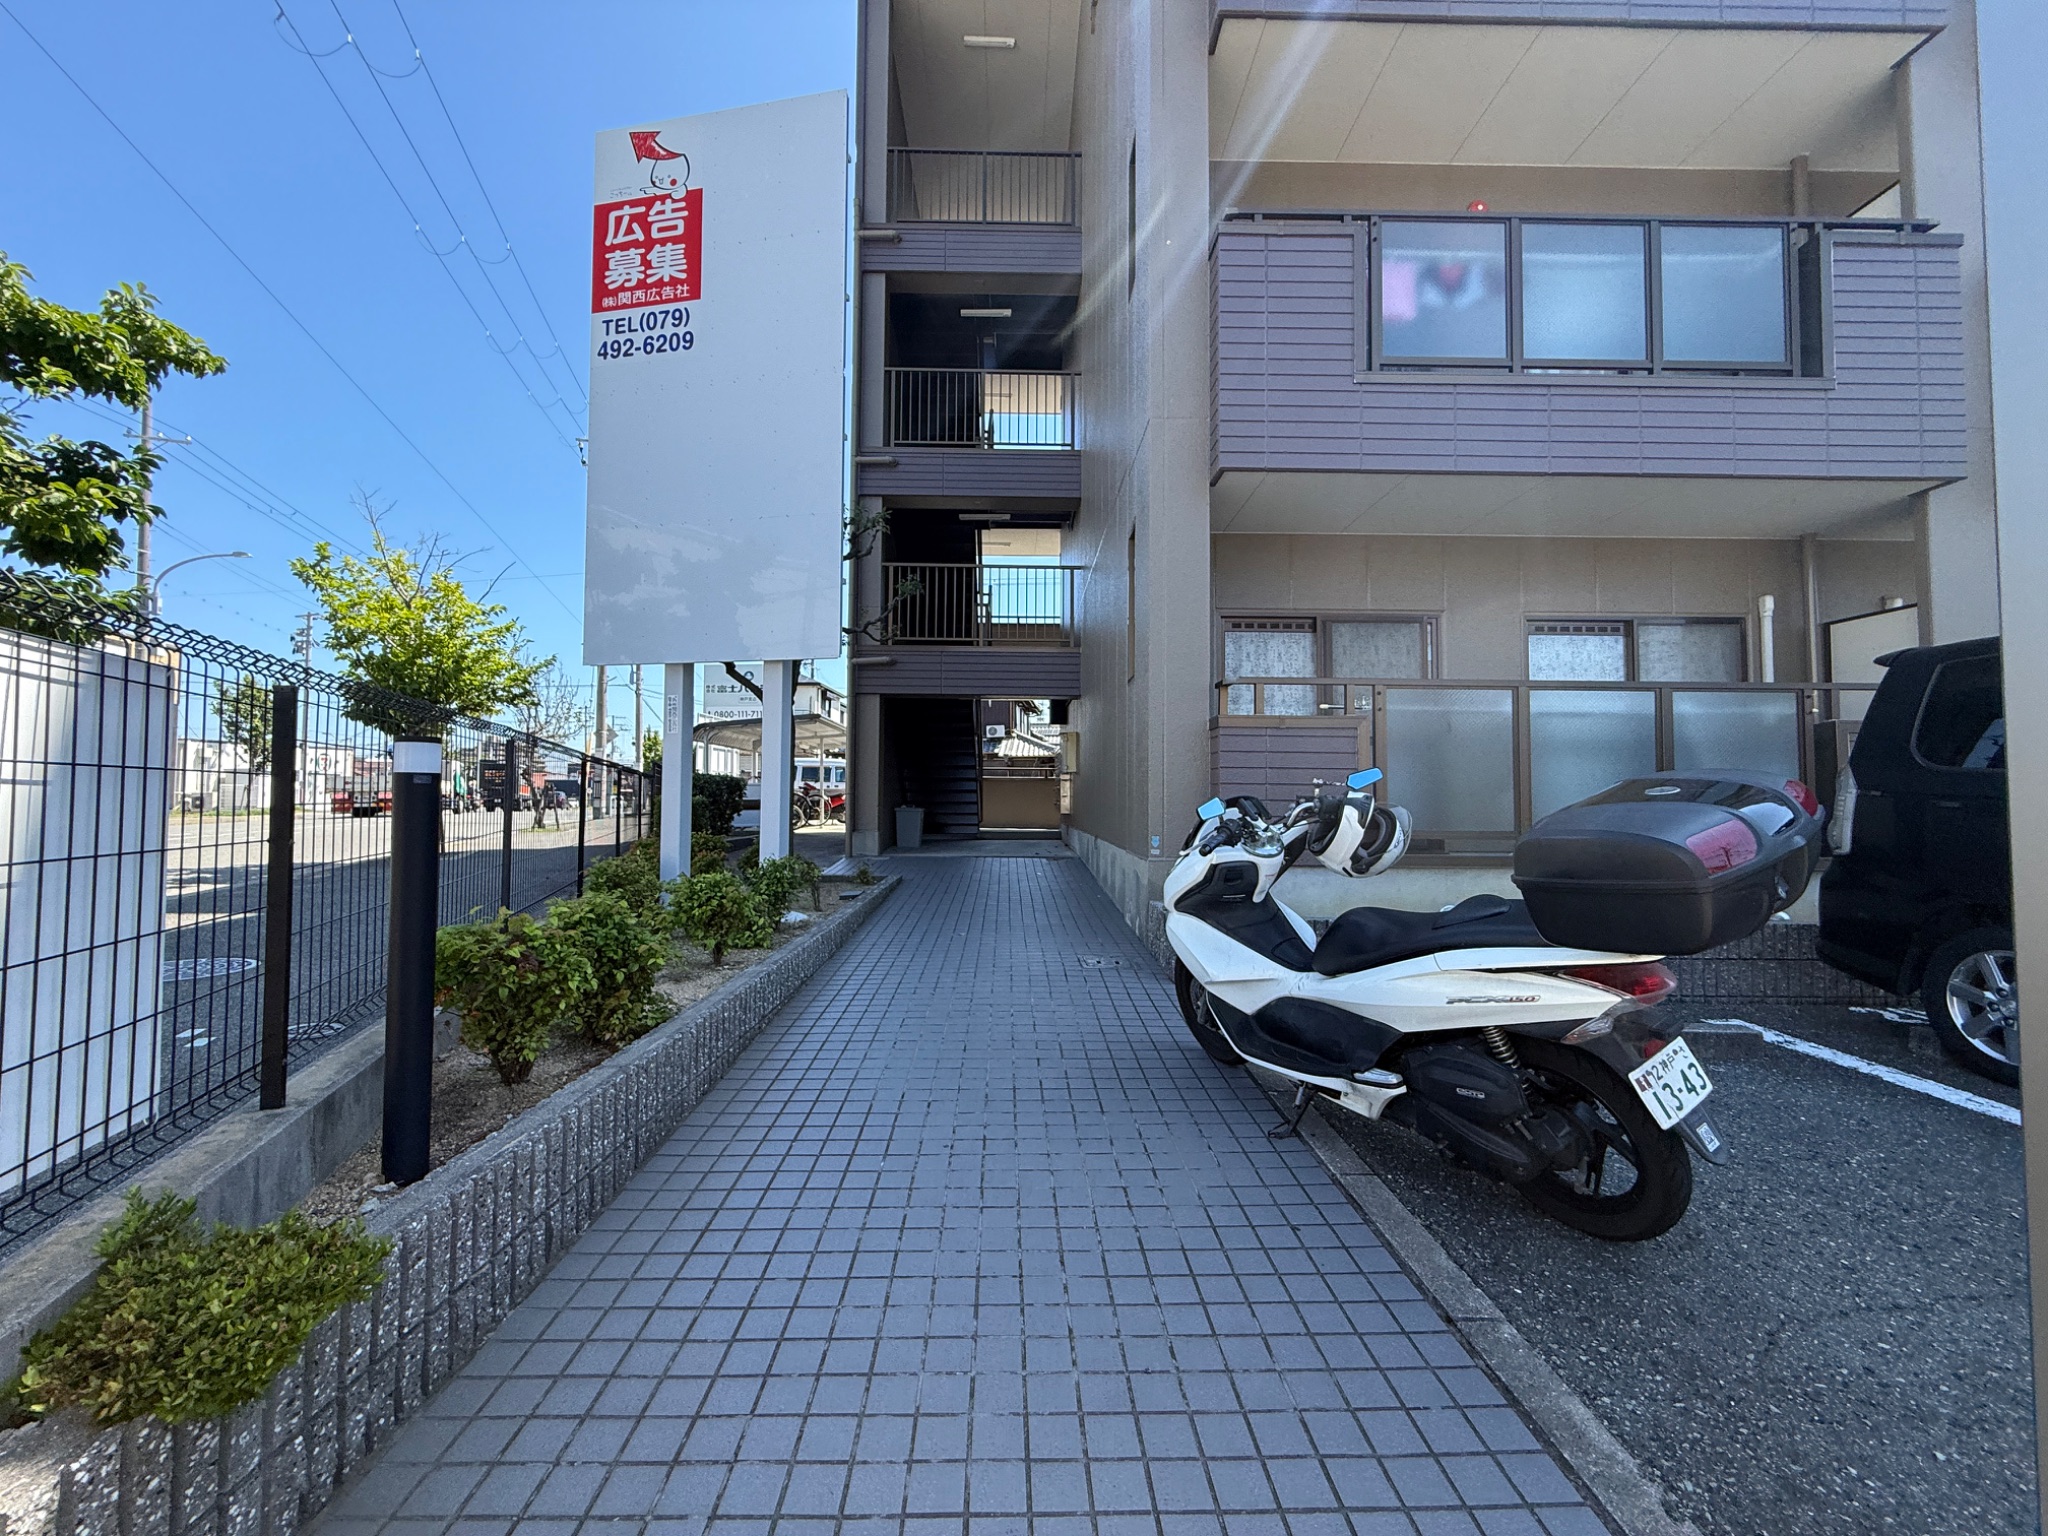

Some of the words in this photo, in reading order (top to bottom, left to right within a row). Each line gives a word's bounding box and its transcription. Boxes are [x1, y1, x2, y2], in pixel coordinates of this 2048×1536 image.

[604, 198, 688, 246] 広告
[604, 243, 688, 290] 募集
[602, 307, 690, 336] TEL(079)
[597, 330, 694, 360] 492-6209
